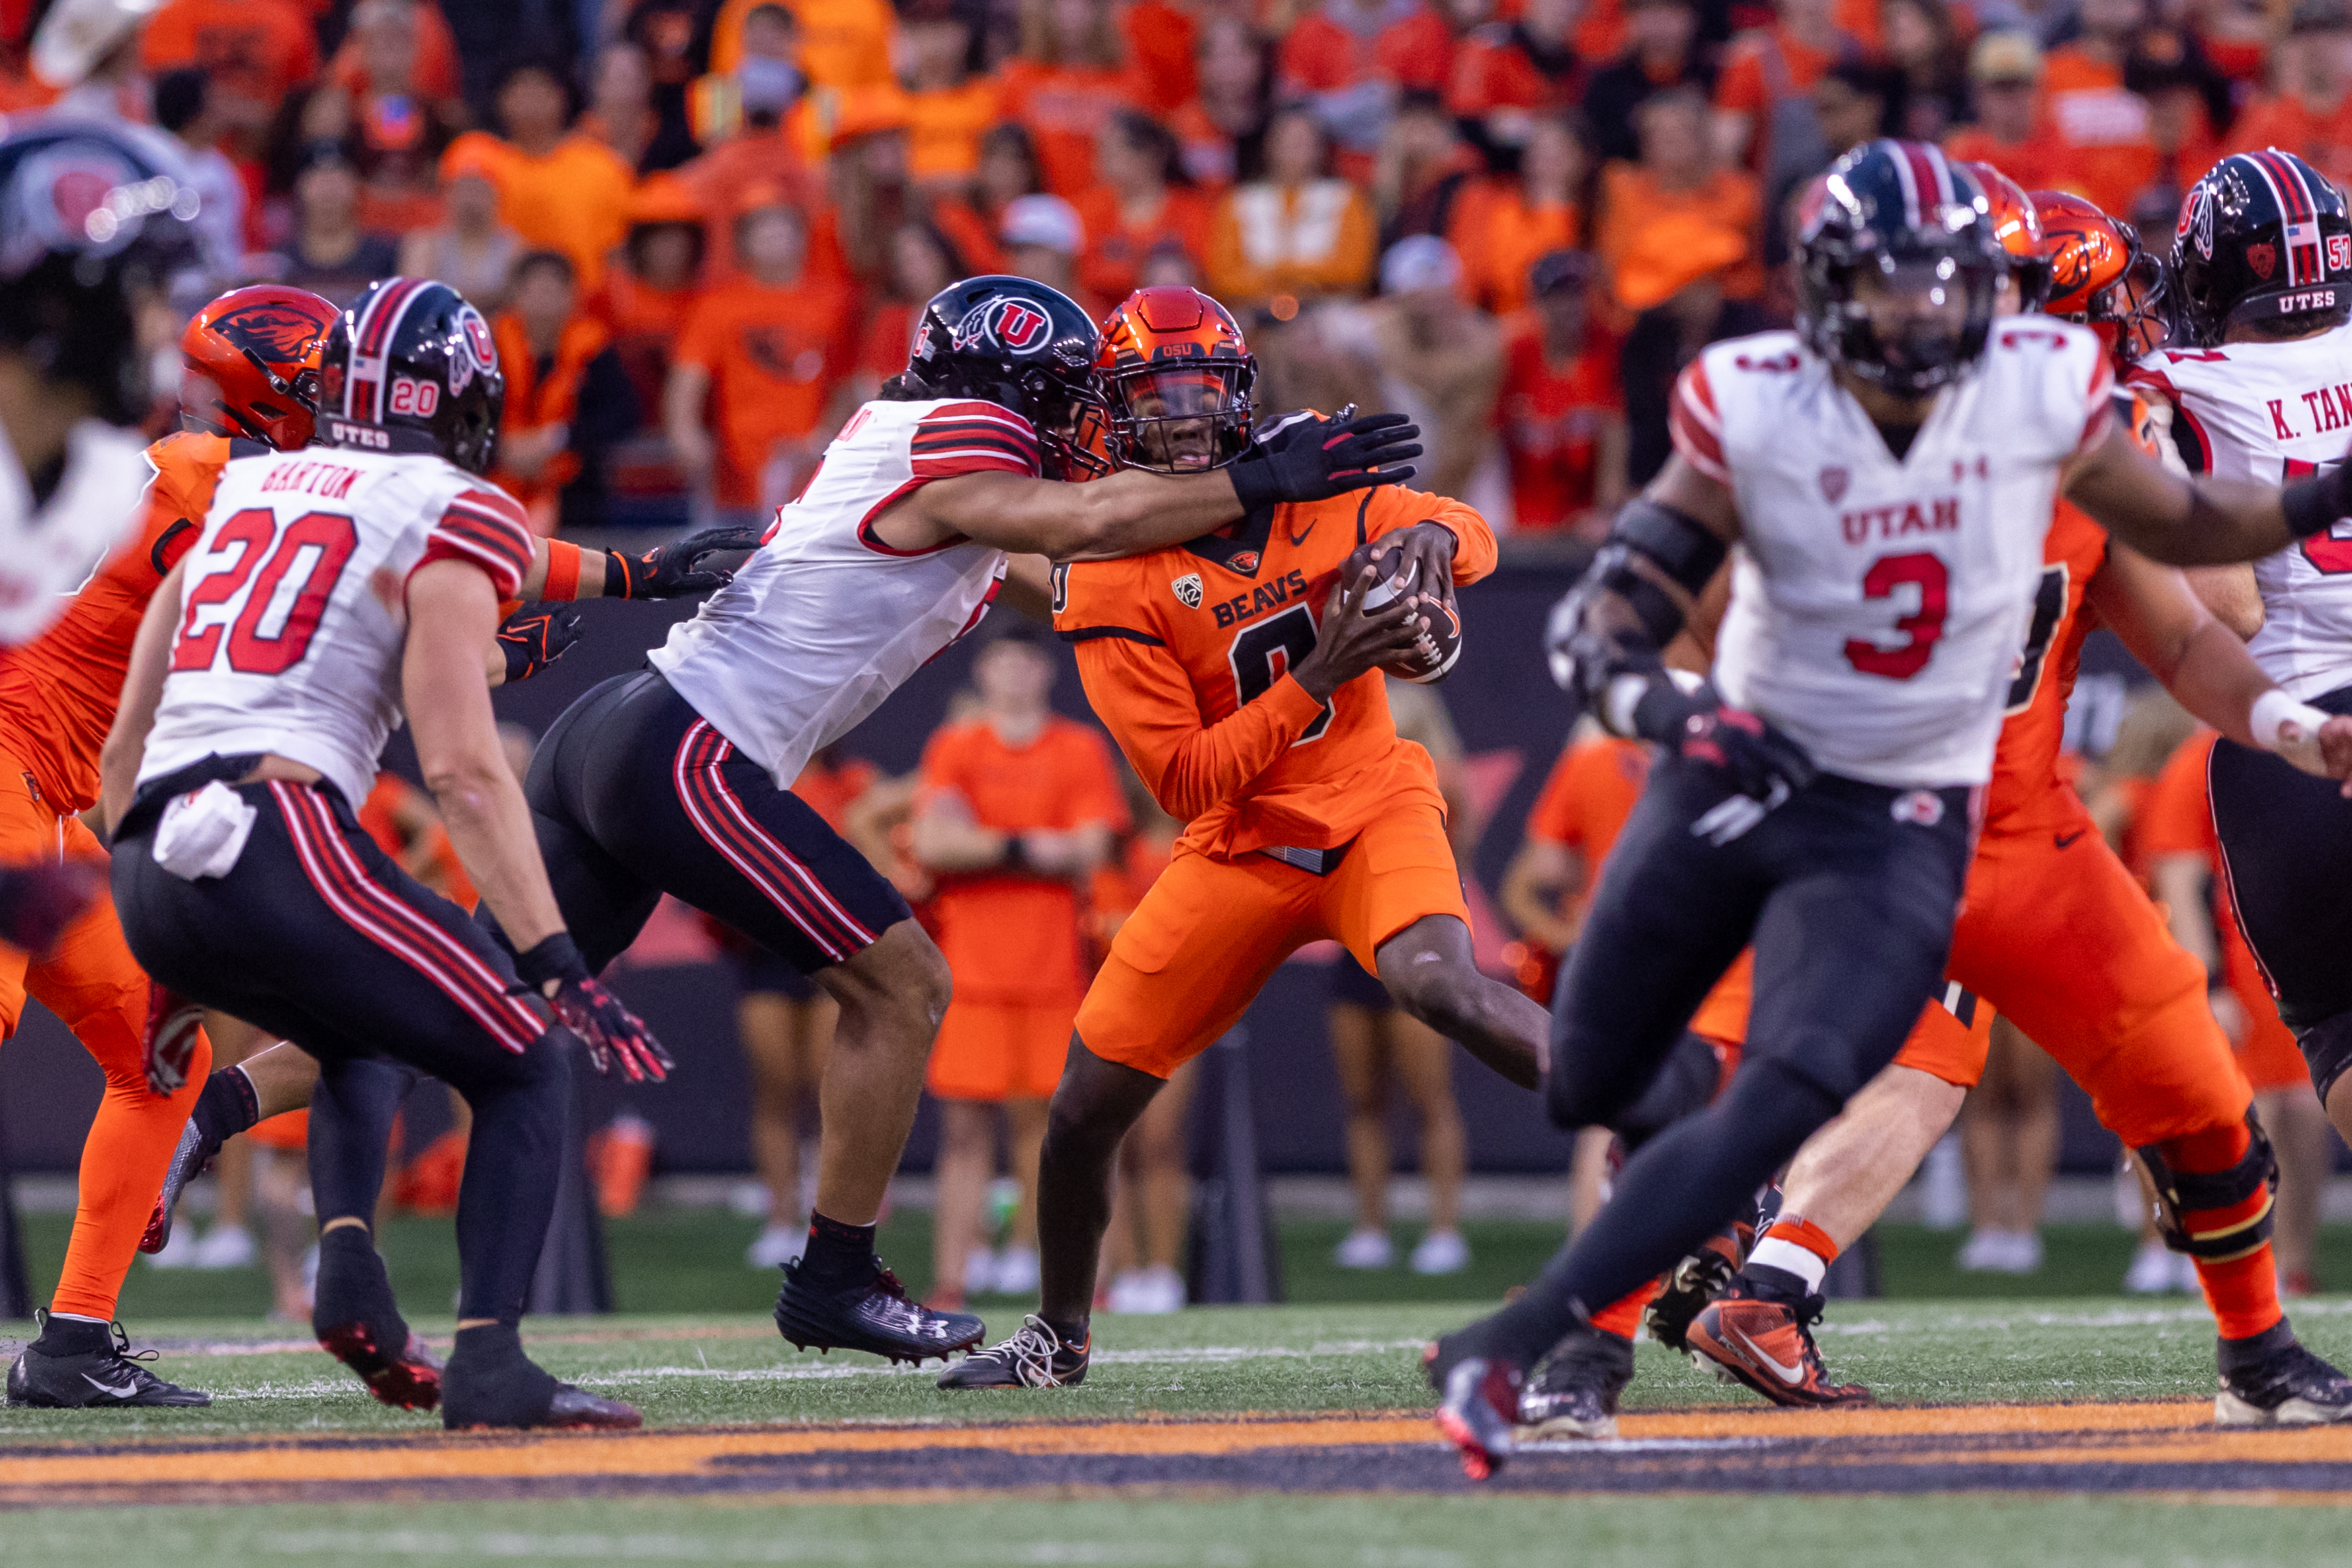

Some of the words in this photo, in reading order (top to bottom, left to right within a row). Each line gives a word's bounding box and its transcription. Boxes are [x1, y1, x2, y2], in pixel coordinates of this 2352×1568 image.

[2326, 234, 2351, 271] 57
[2279, 290, 2335, 314] UTES
[995, 302, 1047, 347] U
[1163, 343, 1192, 357] OSU
[389, 376, 440, 418] 20
[2266, 398, 2302, 440] K.
[2301, 382, 2352, 434] TAN
[332, 422, 390, 449] UTES
[259, 462, 367, 500] BARTON
[1841, 495, 1962, 546] UTAH
[169, 507, 361, 676] 20
[1173, 575, 1202, 600] PAC
[1183, 588, 1200, 604] 12
[1211, 568, 1308, 629] BEAVS
[1845, 552, 1950, 683] 3
